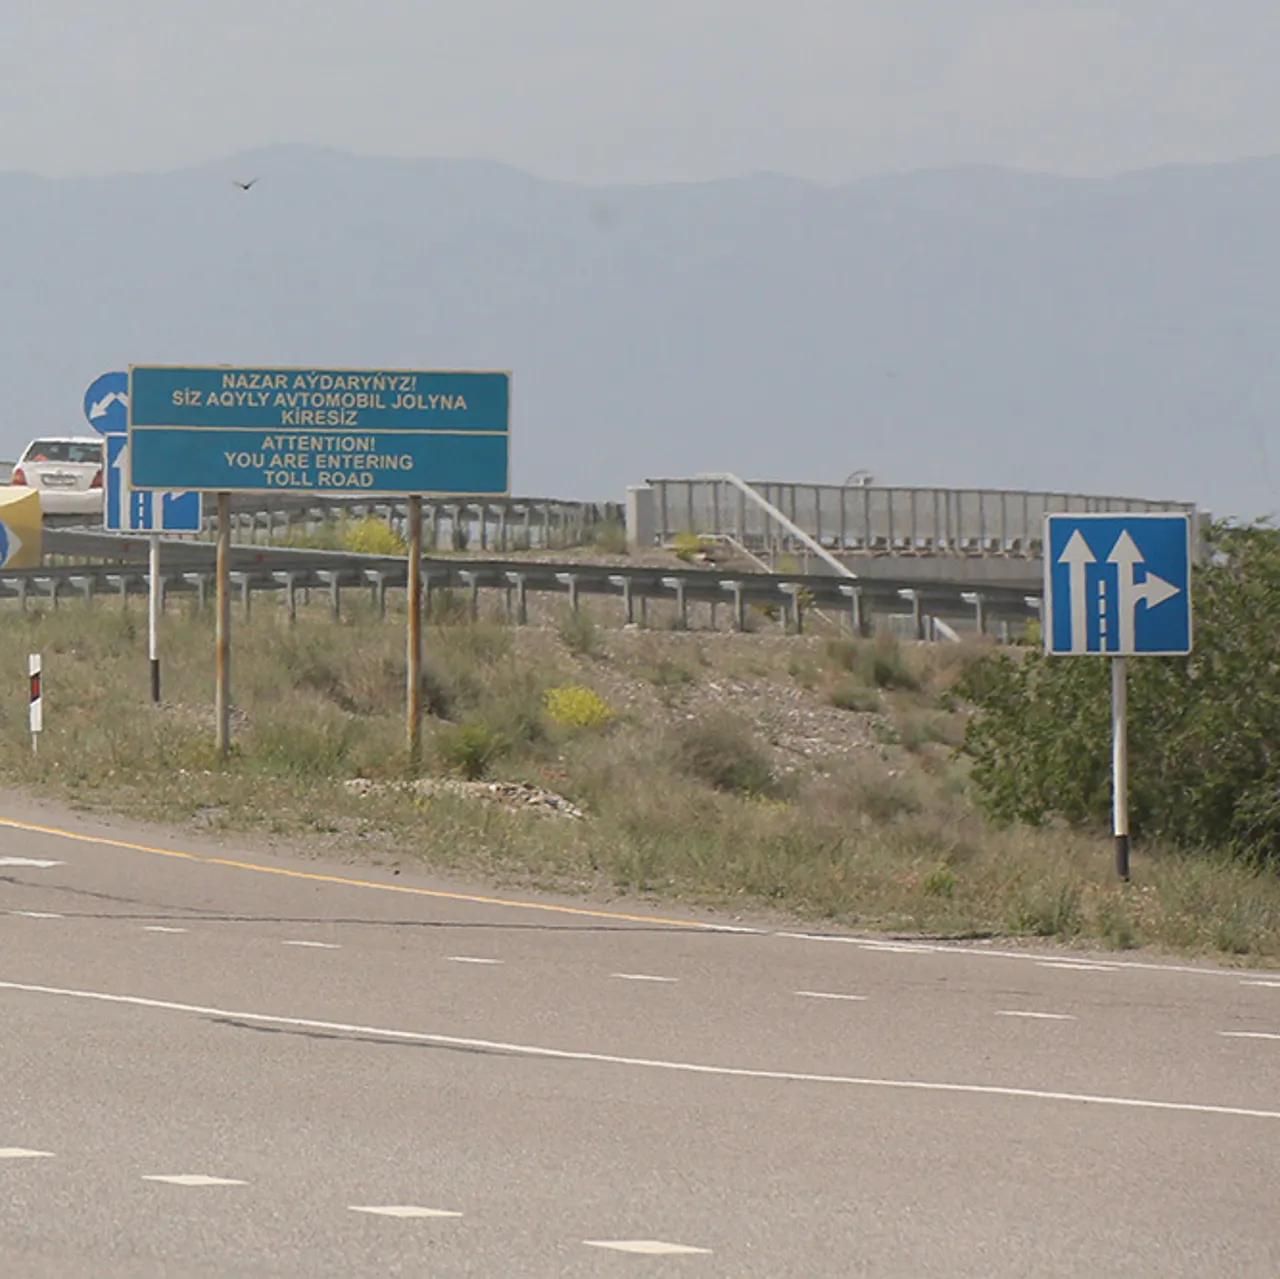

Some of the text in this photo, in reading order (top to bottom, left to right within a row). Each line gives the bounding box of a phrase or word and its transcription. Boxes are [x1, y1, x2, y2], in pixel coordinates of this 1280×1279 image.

[222, 373, 288, 389] NAZAR
[206, 391, 270, 407] AQYLY
[273, 391, 386, 409] AVTOMOBIL
[391, 394, 467, 410] JOLYNA
[261, 435, 376, 452] ATTENTION!
[224, 451, 414, 470] YOU ARE ENTERING
[264, 470, 375, 487] TOLL ROAD
